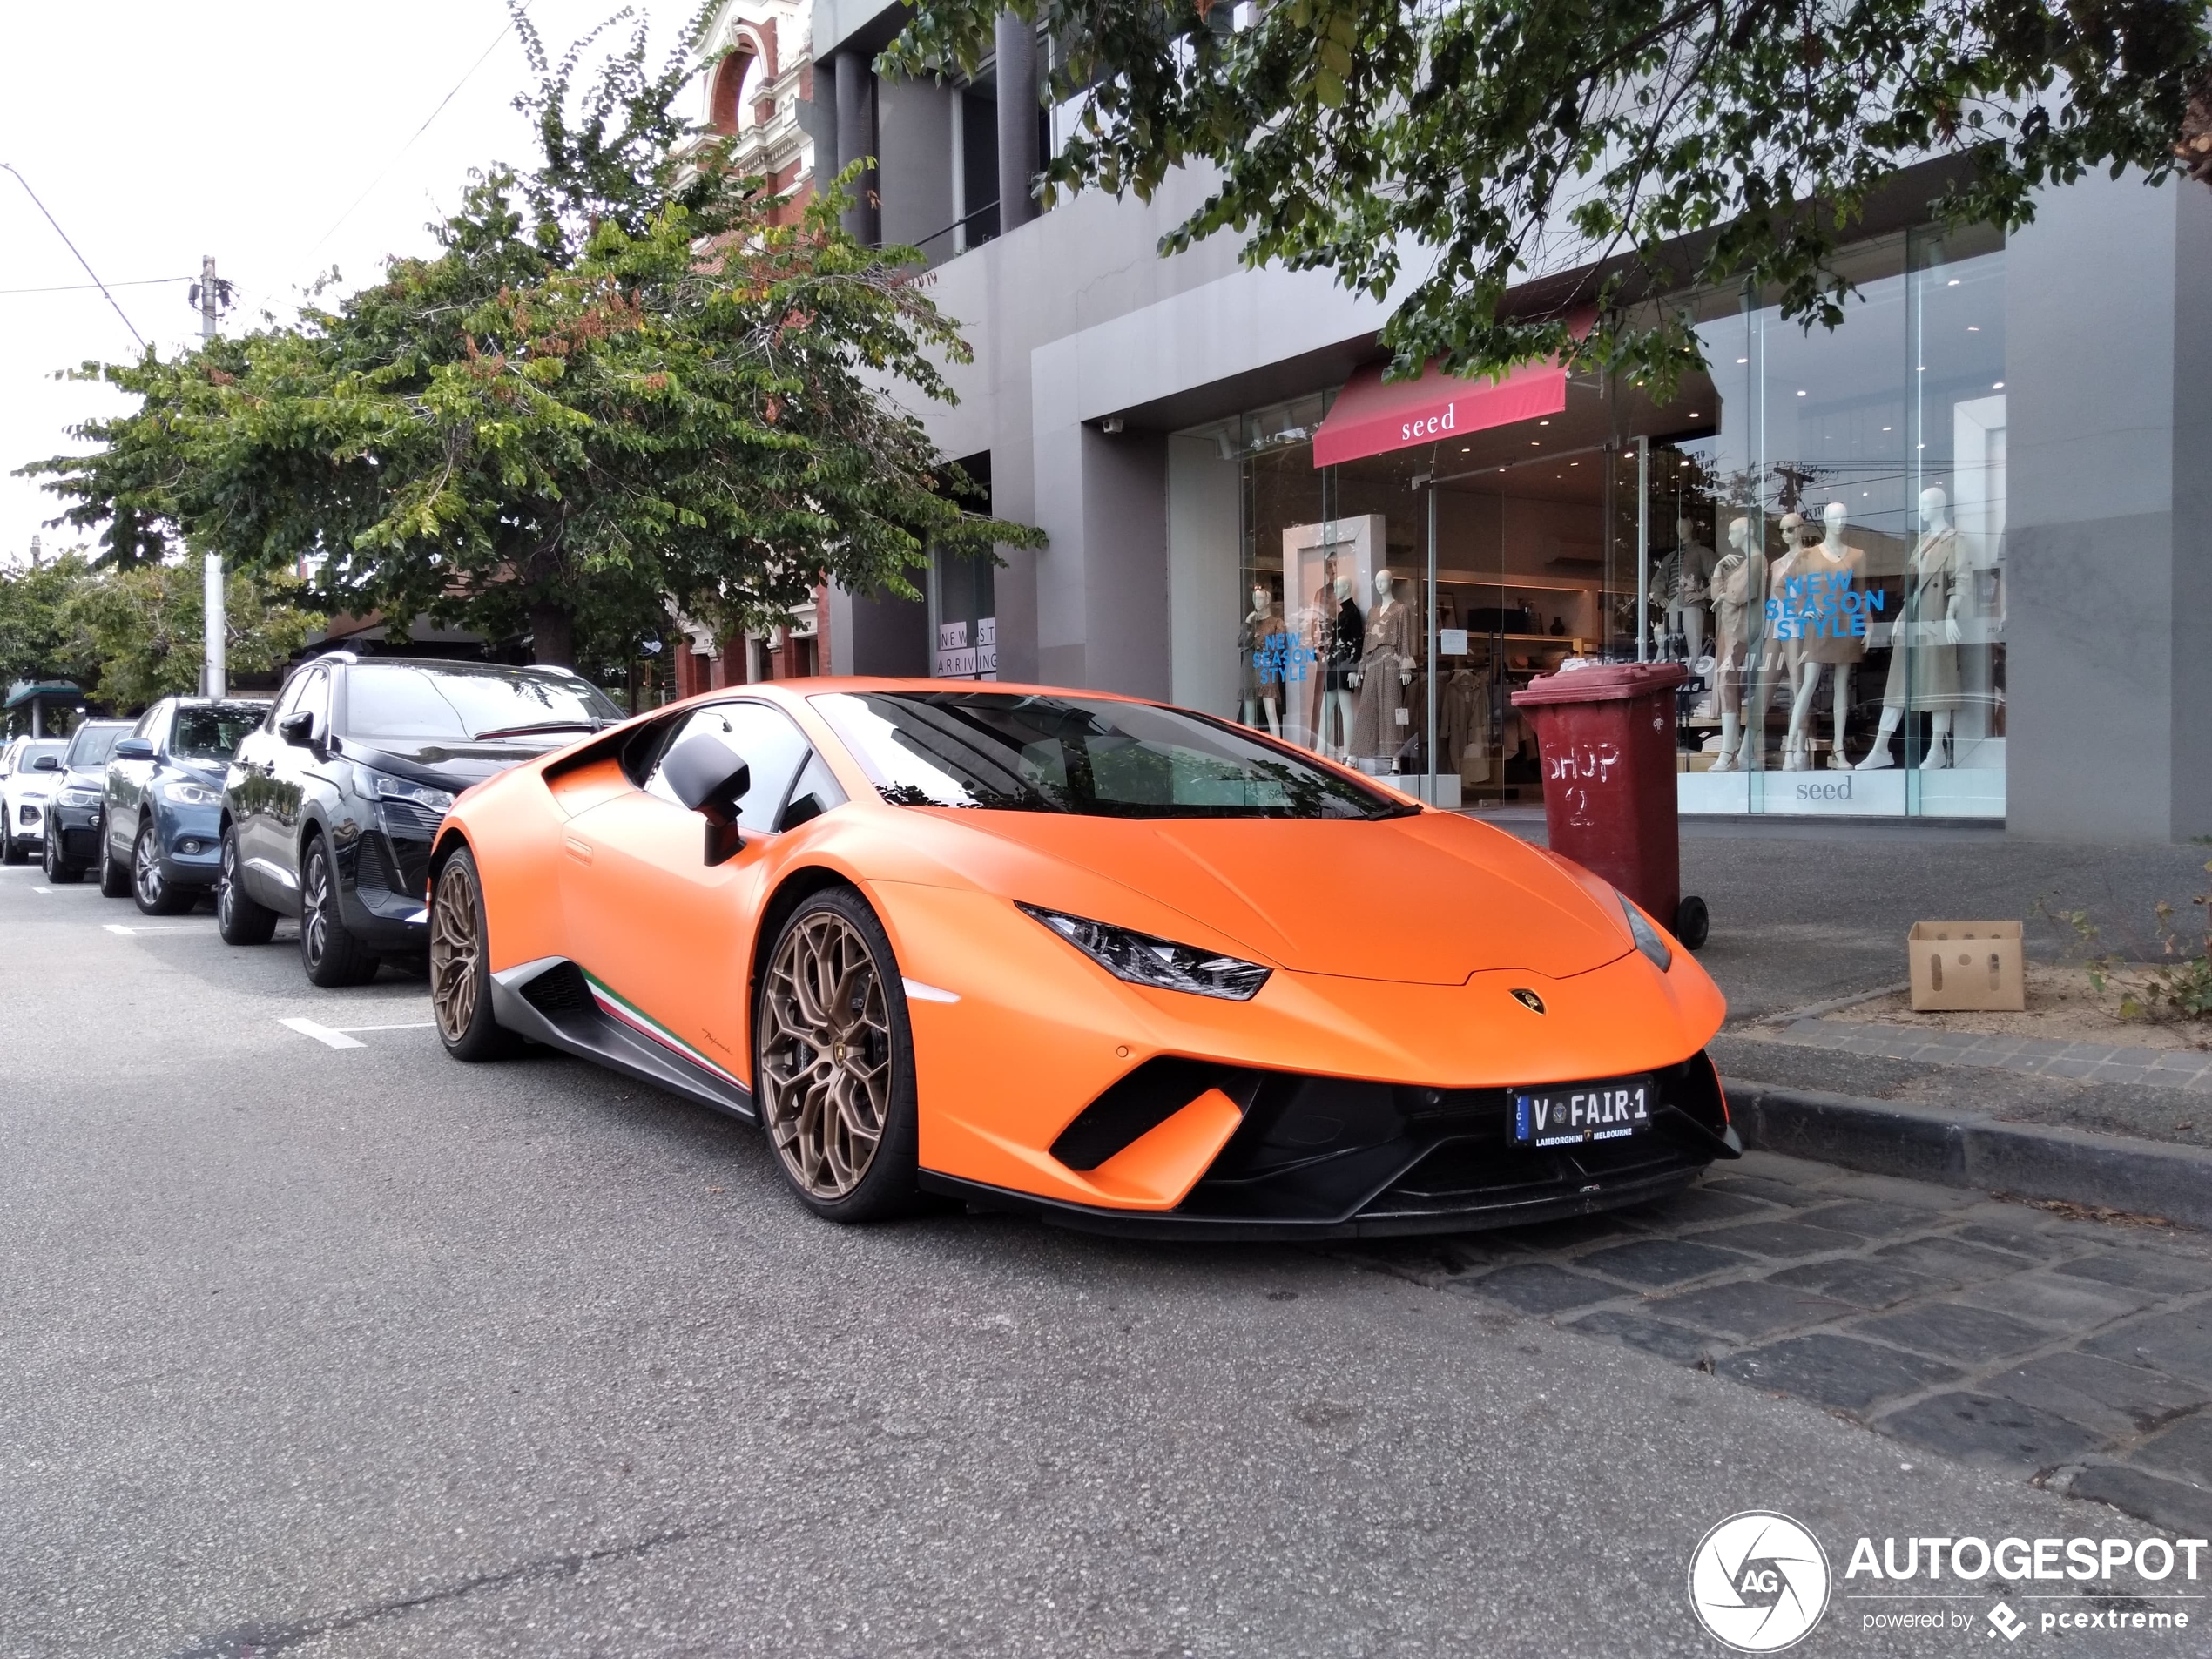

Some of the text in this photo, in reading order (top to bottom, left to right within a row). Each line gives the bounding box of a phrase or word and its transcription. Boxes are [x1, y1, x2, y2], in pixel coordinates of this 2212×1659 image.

[1402, 402, 1455, 441] seed
[1785, 569, 1853, 597] NEW
[1765, 589, 1885, 620] SEASON
[941, 630, 968, 647] NEW
[1777, 614, 1866, 642] STYLE
[1264, 631, 1302, 651] NEW
[1252, 647, 1316, 669] SEASON
[1260, 665, 1307, 685] STYLE
[1796, 774, 1853, 800] seed
[1535, 1128, 1632, 1147] LAMBORGHINI MELBOURNE
